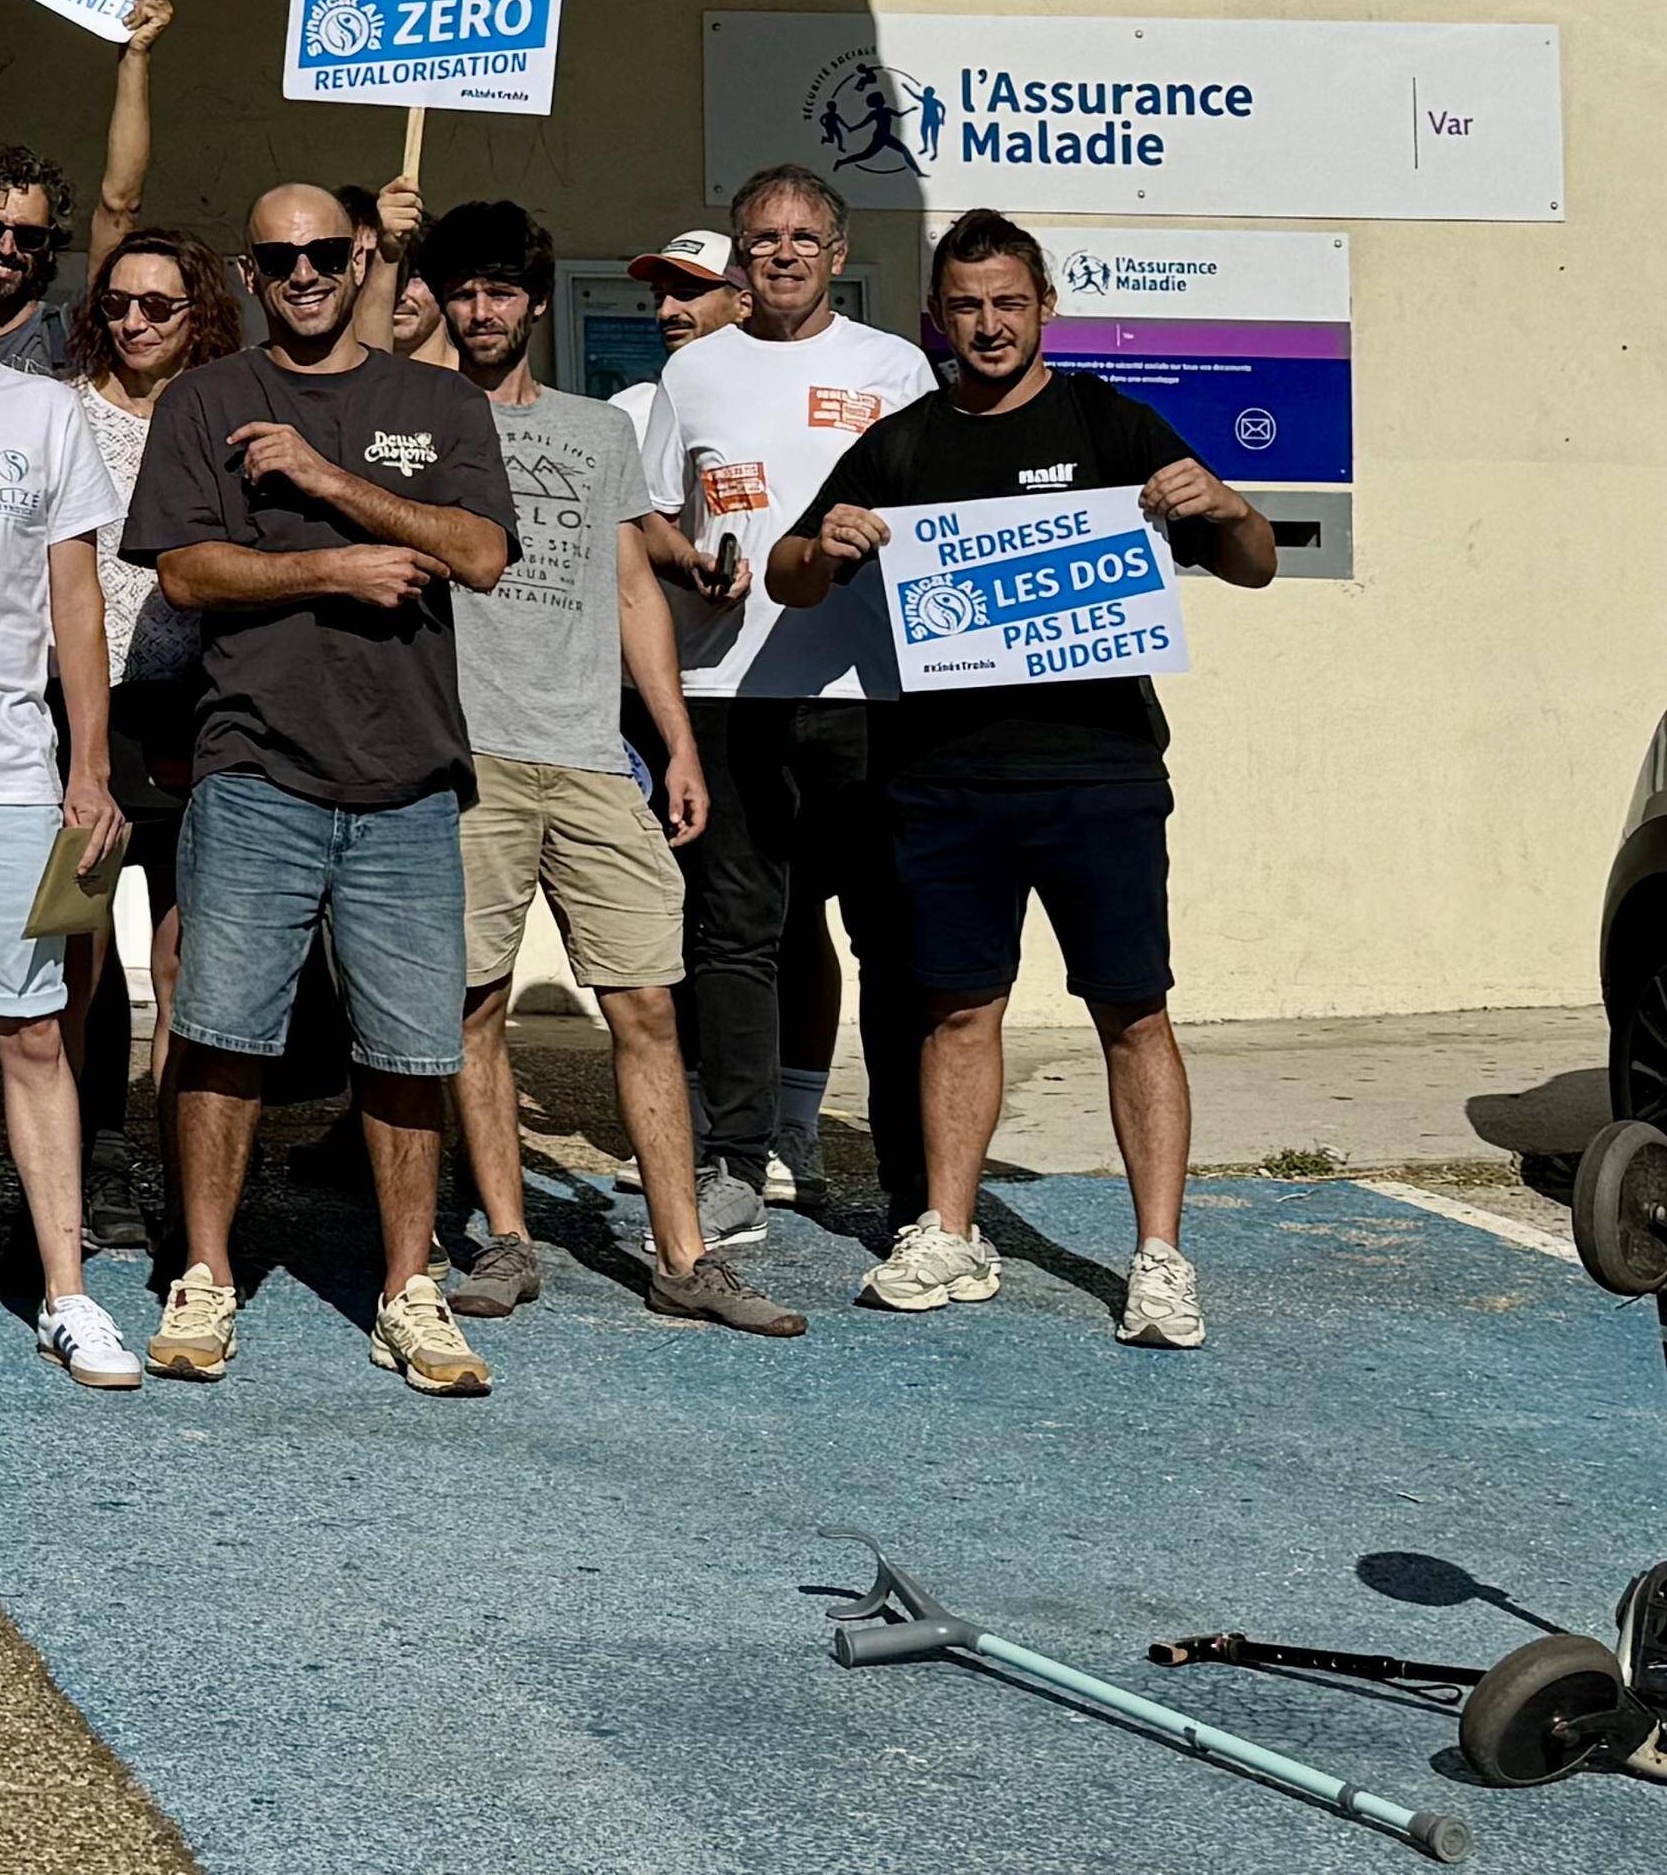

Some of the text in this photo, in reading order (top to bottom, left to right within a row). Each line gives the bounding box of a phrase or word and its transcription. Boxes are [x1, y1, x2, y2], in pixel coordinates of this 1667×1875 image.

[314, 51, 528, 90] REVALORISATION
[961, 67, 1254, 119] l'Assurance
[962, 119, 1165, 167] Maladie
[1427, 110, 1474, 138] Var
[1115, 256, 1218, 276] l'Assurance
[1116, 275, 1188, 292] Maladie
[915, 512, 960, 543] ON
[938, 510, 1092, 566] REDRESSE
[993, 546, 1149, 609] LES DOS
[1002, 602, 1126, 650] PAS LES
[1025, 624, 1170, 678] BUDGETS
